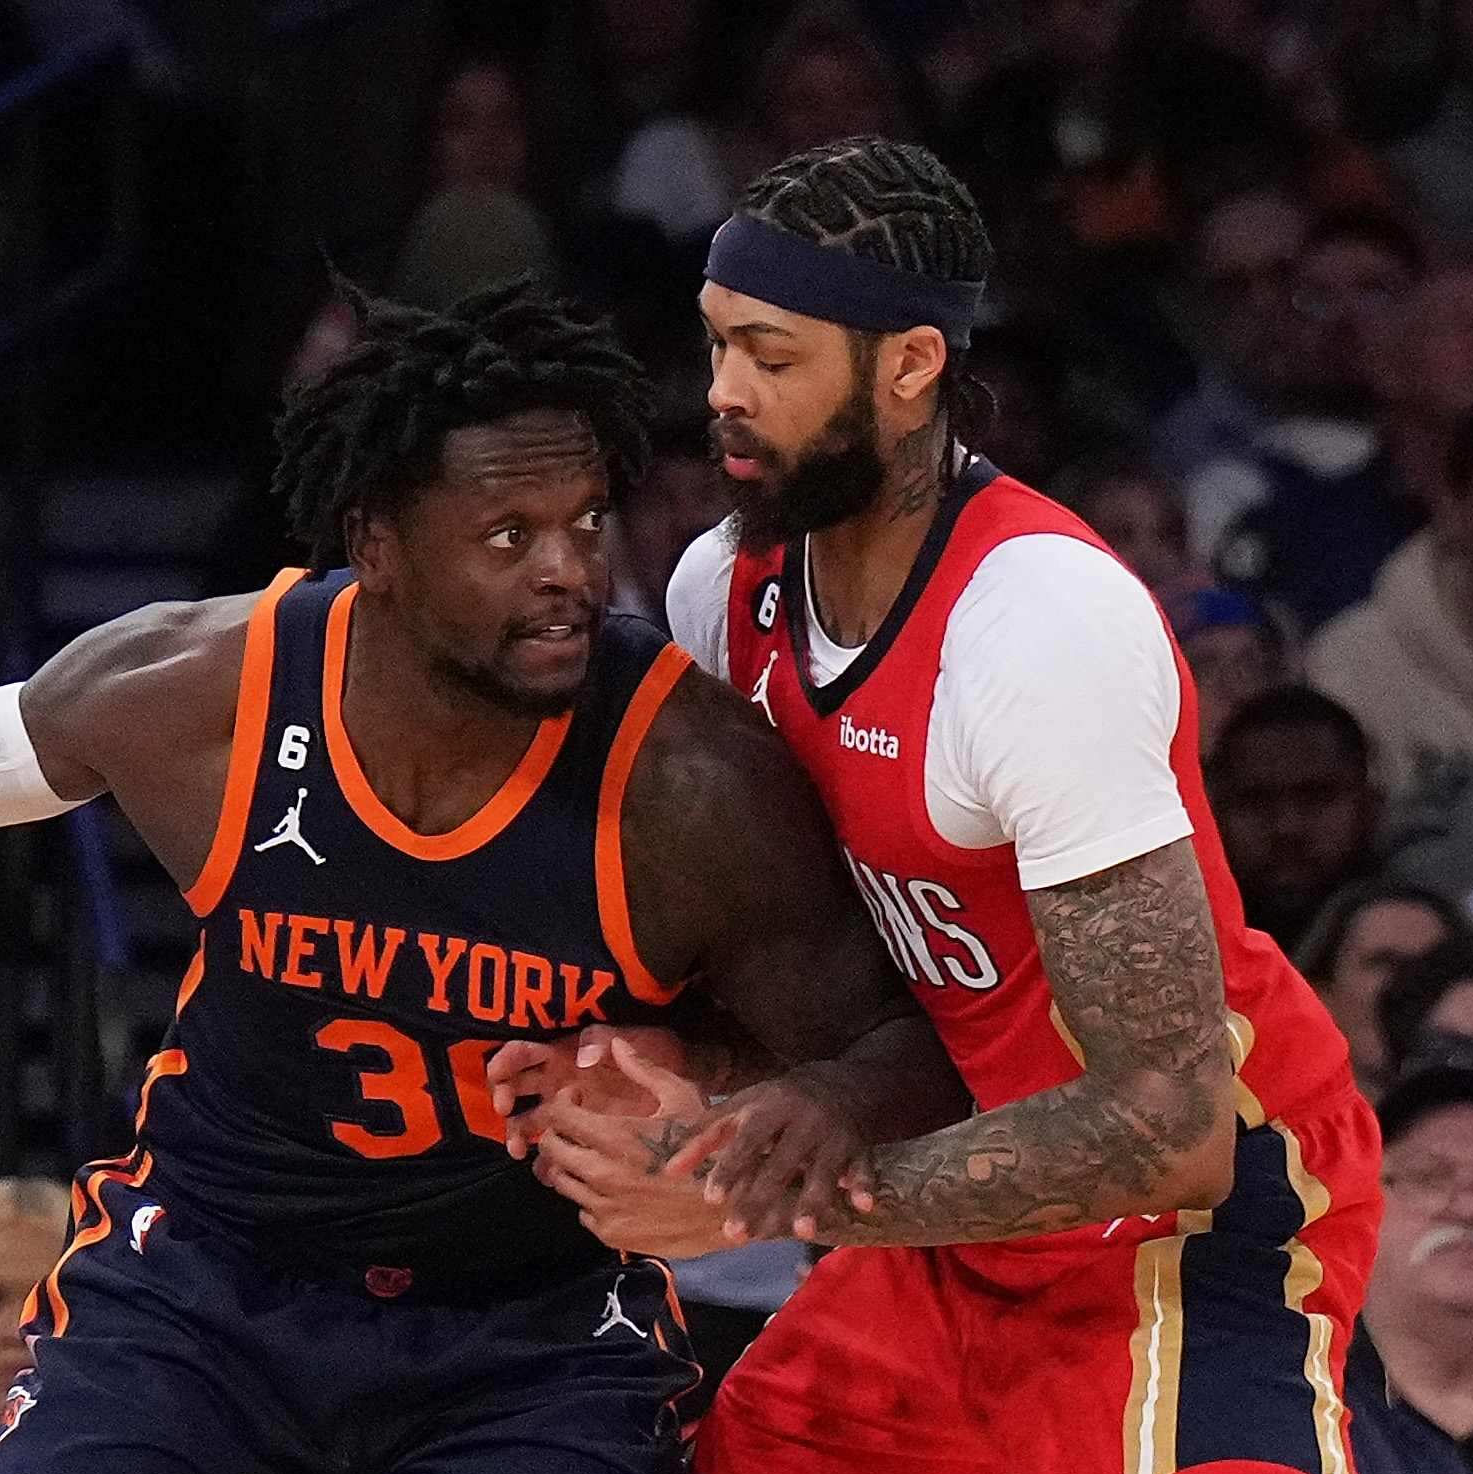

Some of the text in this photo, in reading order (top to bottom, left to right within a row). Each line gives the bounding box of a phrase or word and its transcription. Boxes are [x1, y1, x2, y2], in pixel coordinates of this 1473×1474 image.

[758, 582, 781, 628] 6
[278, 725, 310, 770] 6
[840, 715, 900, 760] ibotta
[238, 908, 615, 1029] NEW YORK
